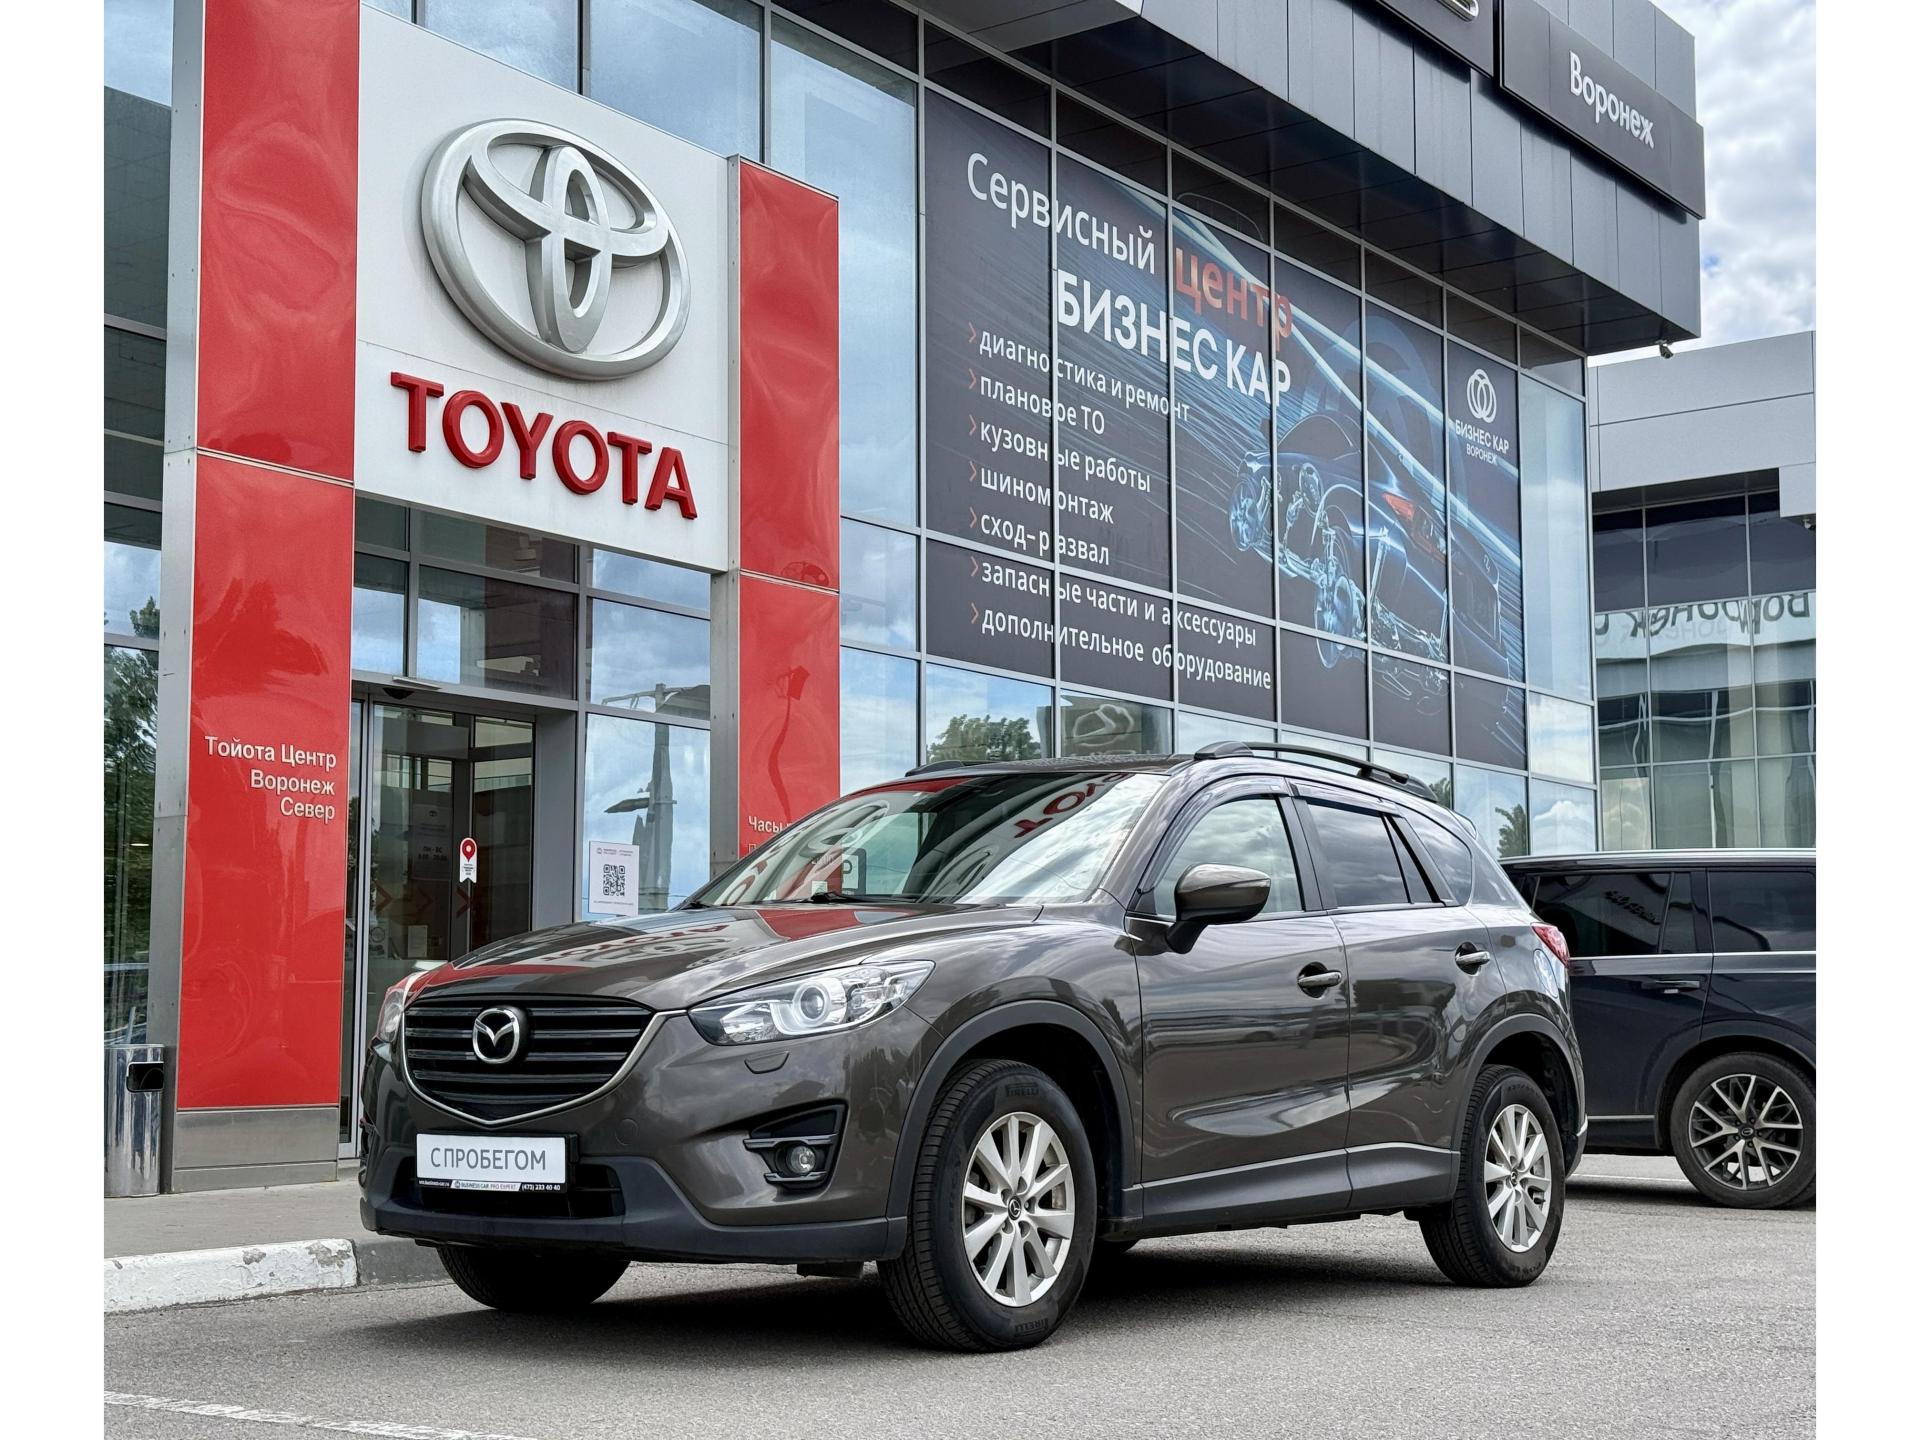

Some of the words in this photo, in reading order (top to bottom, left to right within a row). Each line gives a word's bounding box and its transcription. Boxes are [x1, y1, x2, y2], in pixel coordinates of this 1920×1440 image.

[1569, 50, 1655, 149] Воронеж
[966, 152, 1156, 275] Сервисный
[1175, 247, 1292, 351] центр
[1057, 270, 1218, 381] БИЗНЕС
[1226, 345, 1291, 407] КАР
[979, 329, 1106, 393] диагностика
[1111, 375, 1122, 400] и
[1126, 380, 1189, 422] ремонт
[980, 375, 1078, 425] плановое
[1080, 402, 1105, 435] ТО
[389, 371, 698, 520] TOYOTA
[980, 421, 1080, 471] кузовные
[1085, 455, 1151, 493] работы
[1455, 419, 1492, 447] БИЗНЕС
[1492, 434, 1509, 454] КАР
[1466, 443, 1498, 466] ВОРОНЕЖ
[981, 466, 1114, 525] шиномонтаж
[982, 562, 1081, 604] запасные
[1086, 587, 1137, 619] части
[1144, 599, 1155, 622] и
[1162, 605, 1256, 646] аксессуары
[982, 607, 1144, 662] дополнительное
[1152, 643, 1271, 689] оборудование
[204, 735, 275, 762] Тойота
[281, 743, 337, 772] Центр
[250, 768, 336, 796] Воронеж
[280, 796, 336, 824] Север
[748, 815, 783, 833] Часы
[430, 1147, 441, 1168] С
[444, 1147, 546, 1171] ПРОБЕГОМ
